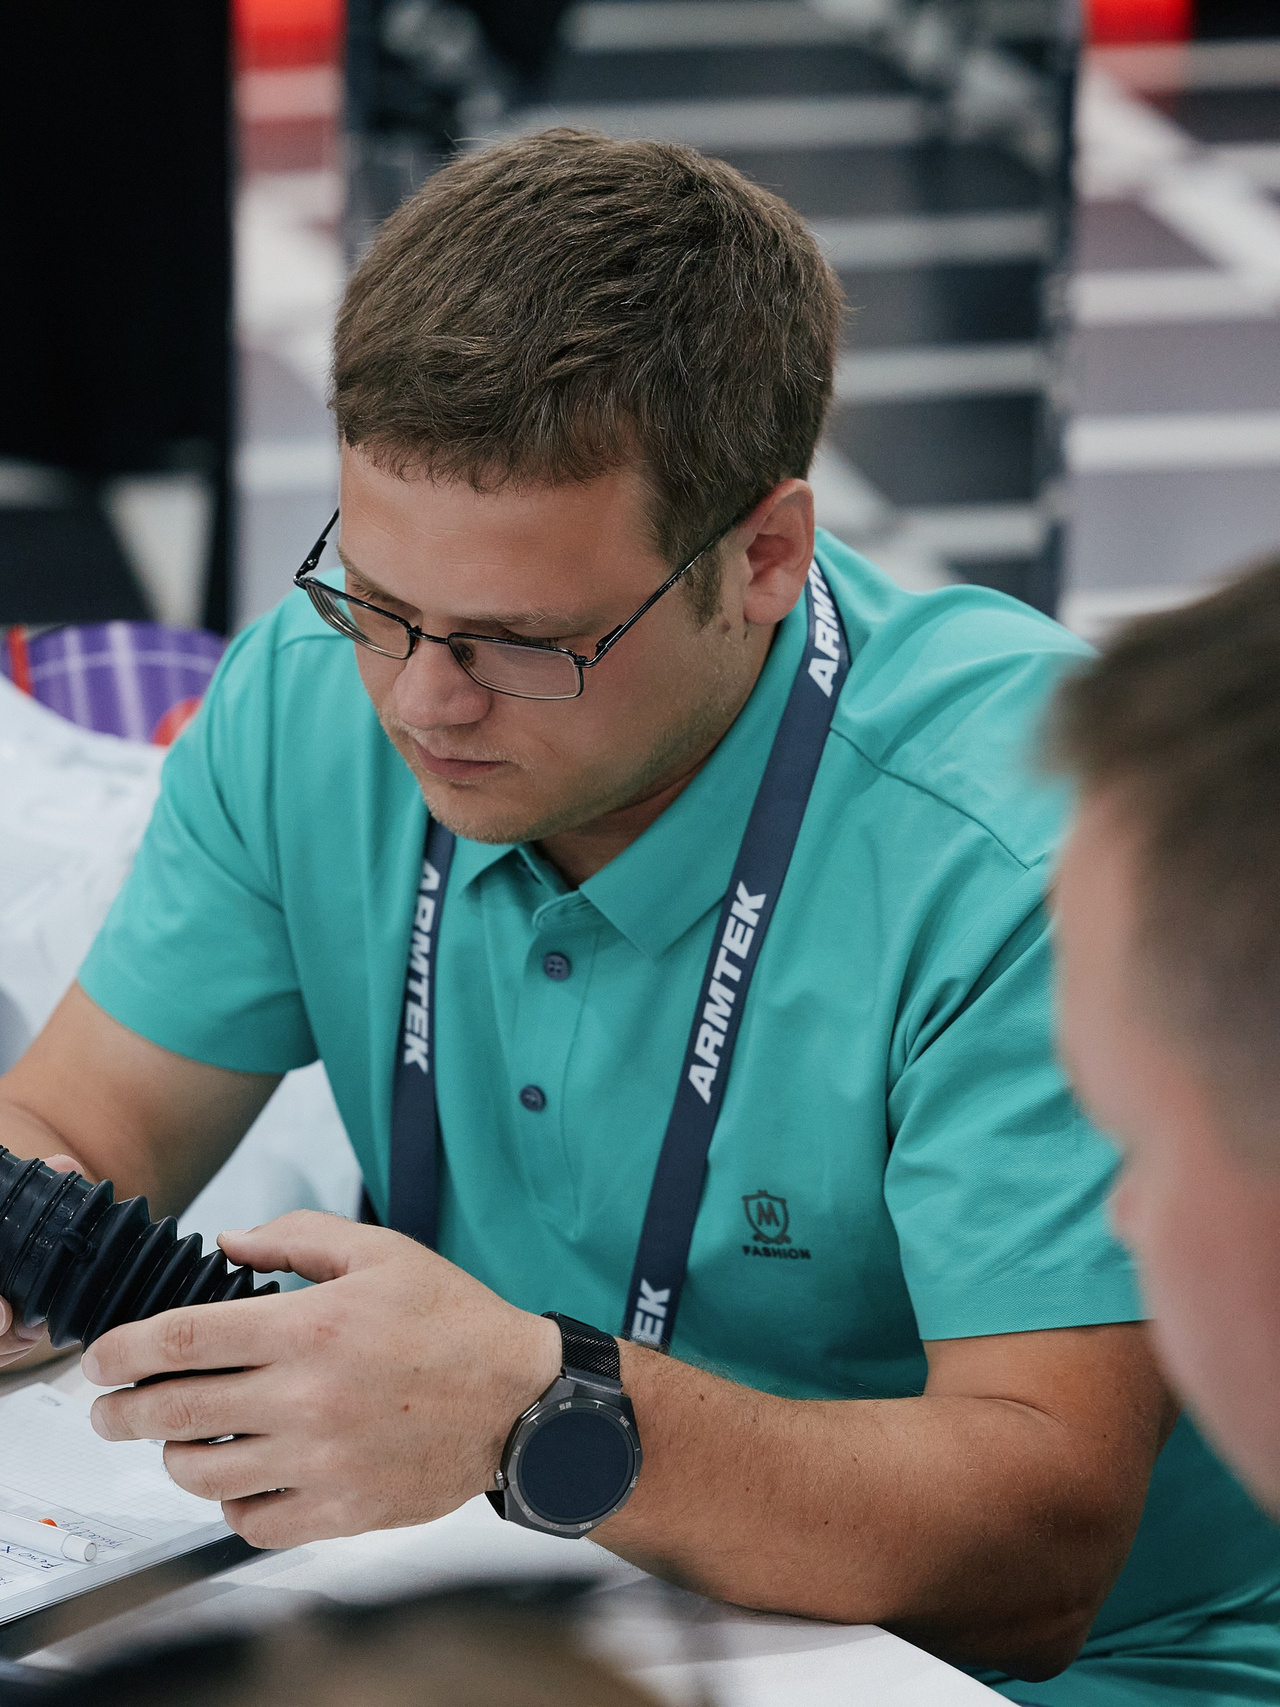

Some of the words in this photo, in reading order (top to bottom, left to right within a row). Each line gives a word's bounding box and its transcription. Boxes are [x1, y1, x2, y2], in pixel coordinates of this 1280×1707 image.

[403, 858, 442, 1074] ARMTEK
[687, 880, 768, 1105] ARMTEK
[631, 1278, 671, 1345] EK
[741, 1244, 812, 1260] FASHION
